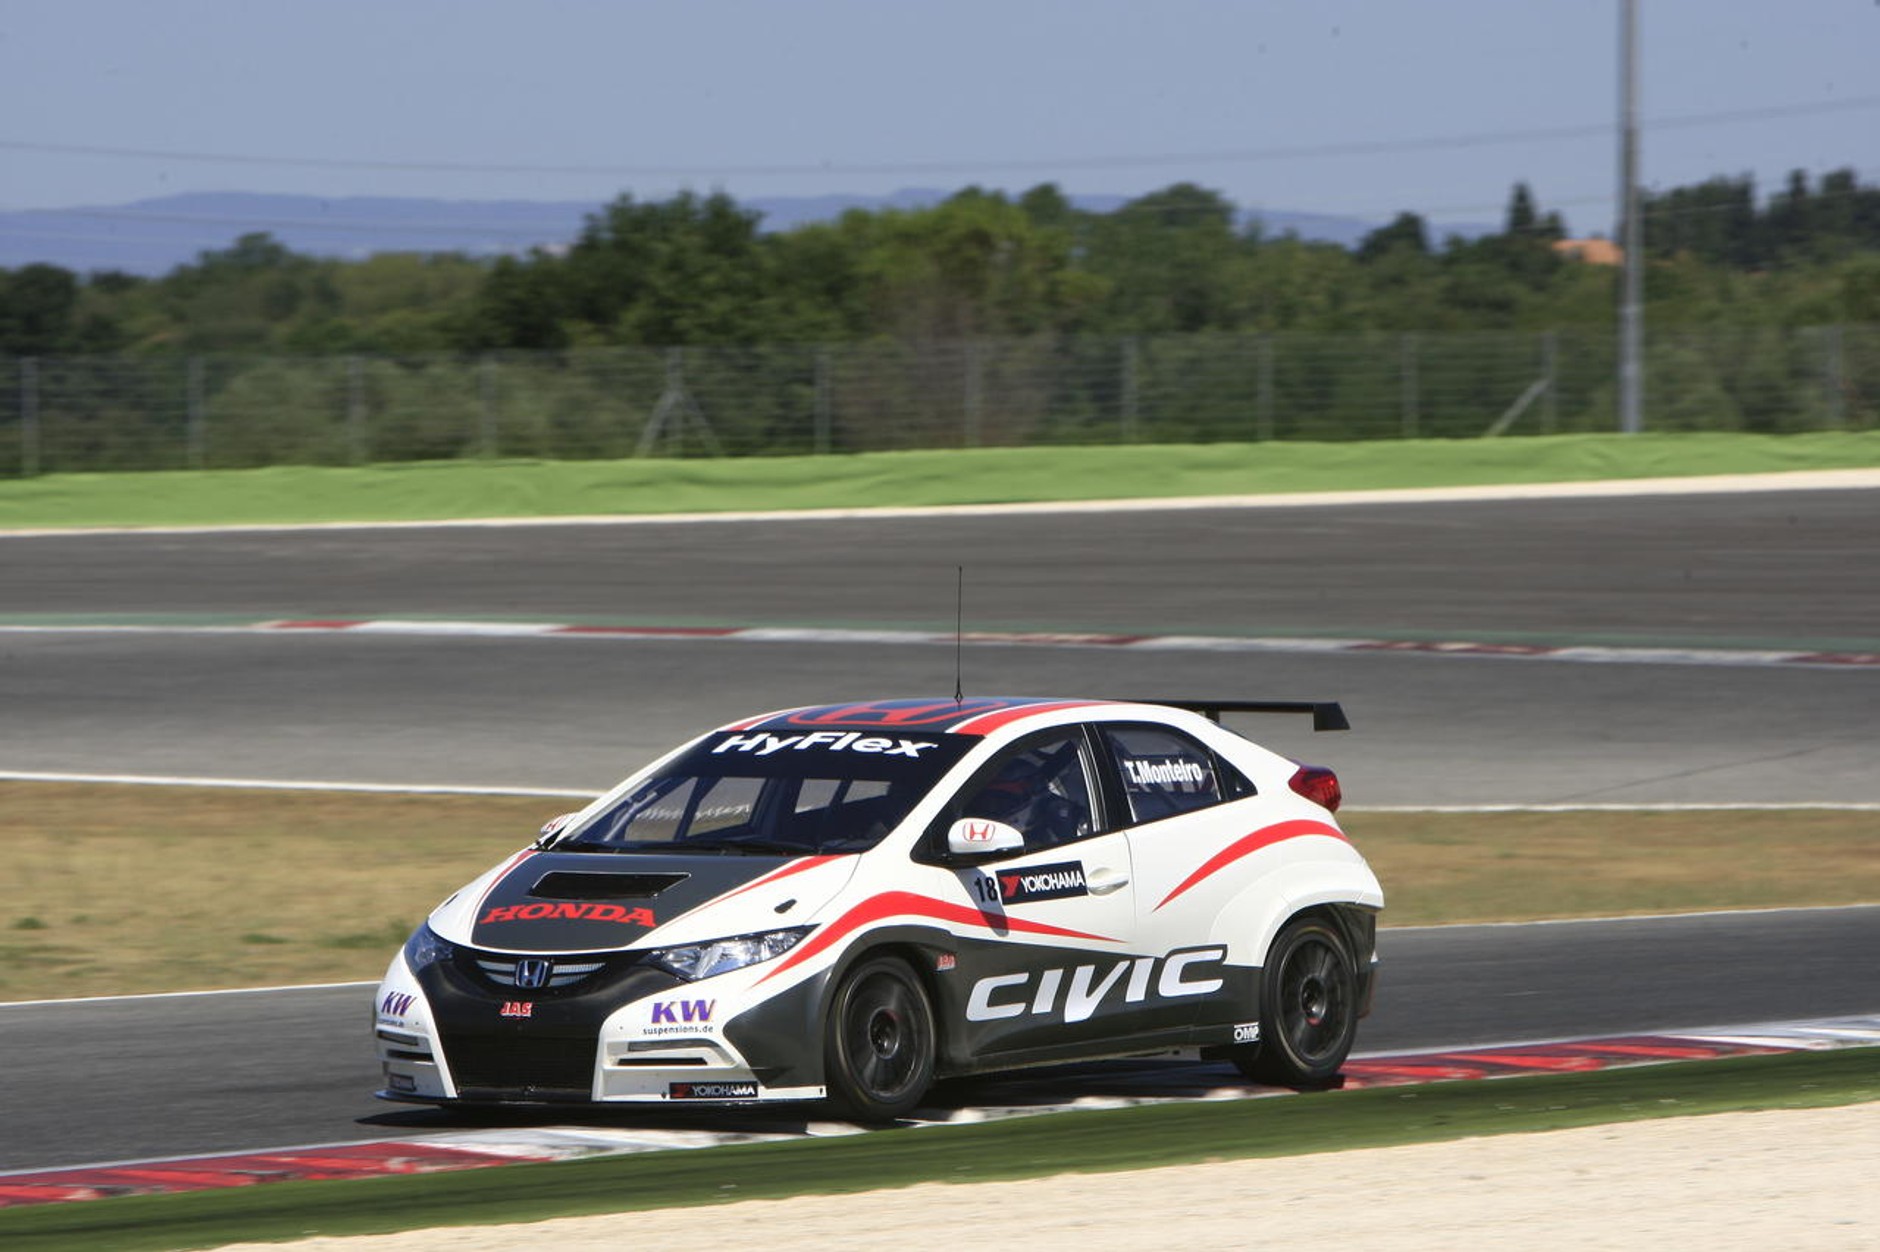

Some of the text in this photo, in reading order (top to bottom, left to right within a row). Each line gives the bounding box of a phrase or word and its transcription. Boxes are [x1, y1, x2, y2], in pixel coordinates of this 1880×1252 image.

[711, 732, 935, 758] HyFlex
[1124, 759, 1203, 784] T.Monteiro
[974, 876, 998, 902] 18
[1020, 870, 1085, 893] YOKOHAMA
[479, 903, 657, 928] HONDA
[966, 949, 1224, 1024] CIVIC
[381, 991, 418, 1017] KW
[651, 999, 717, 1024] KW
[643, 1025, 714, 1036] suspensions.de
[692, 1085, 756, 1097] YOKOHAMA
